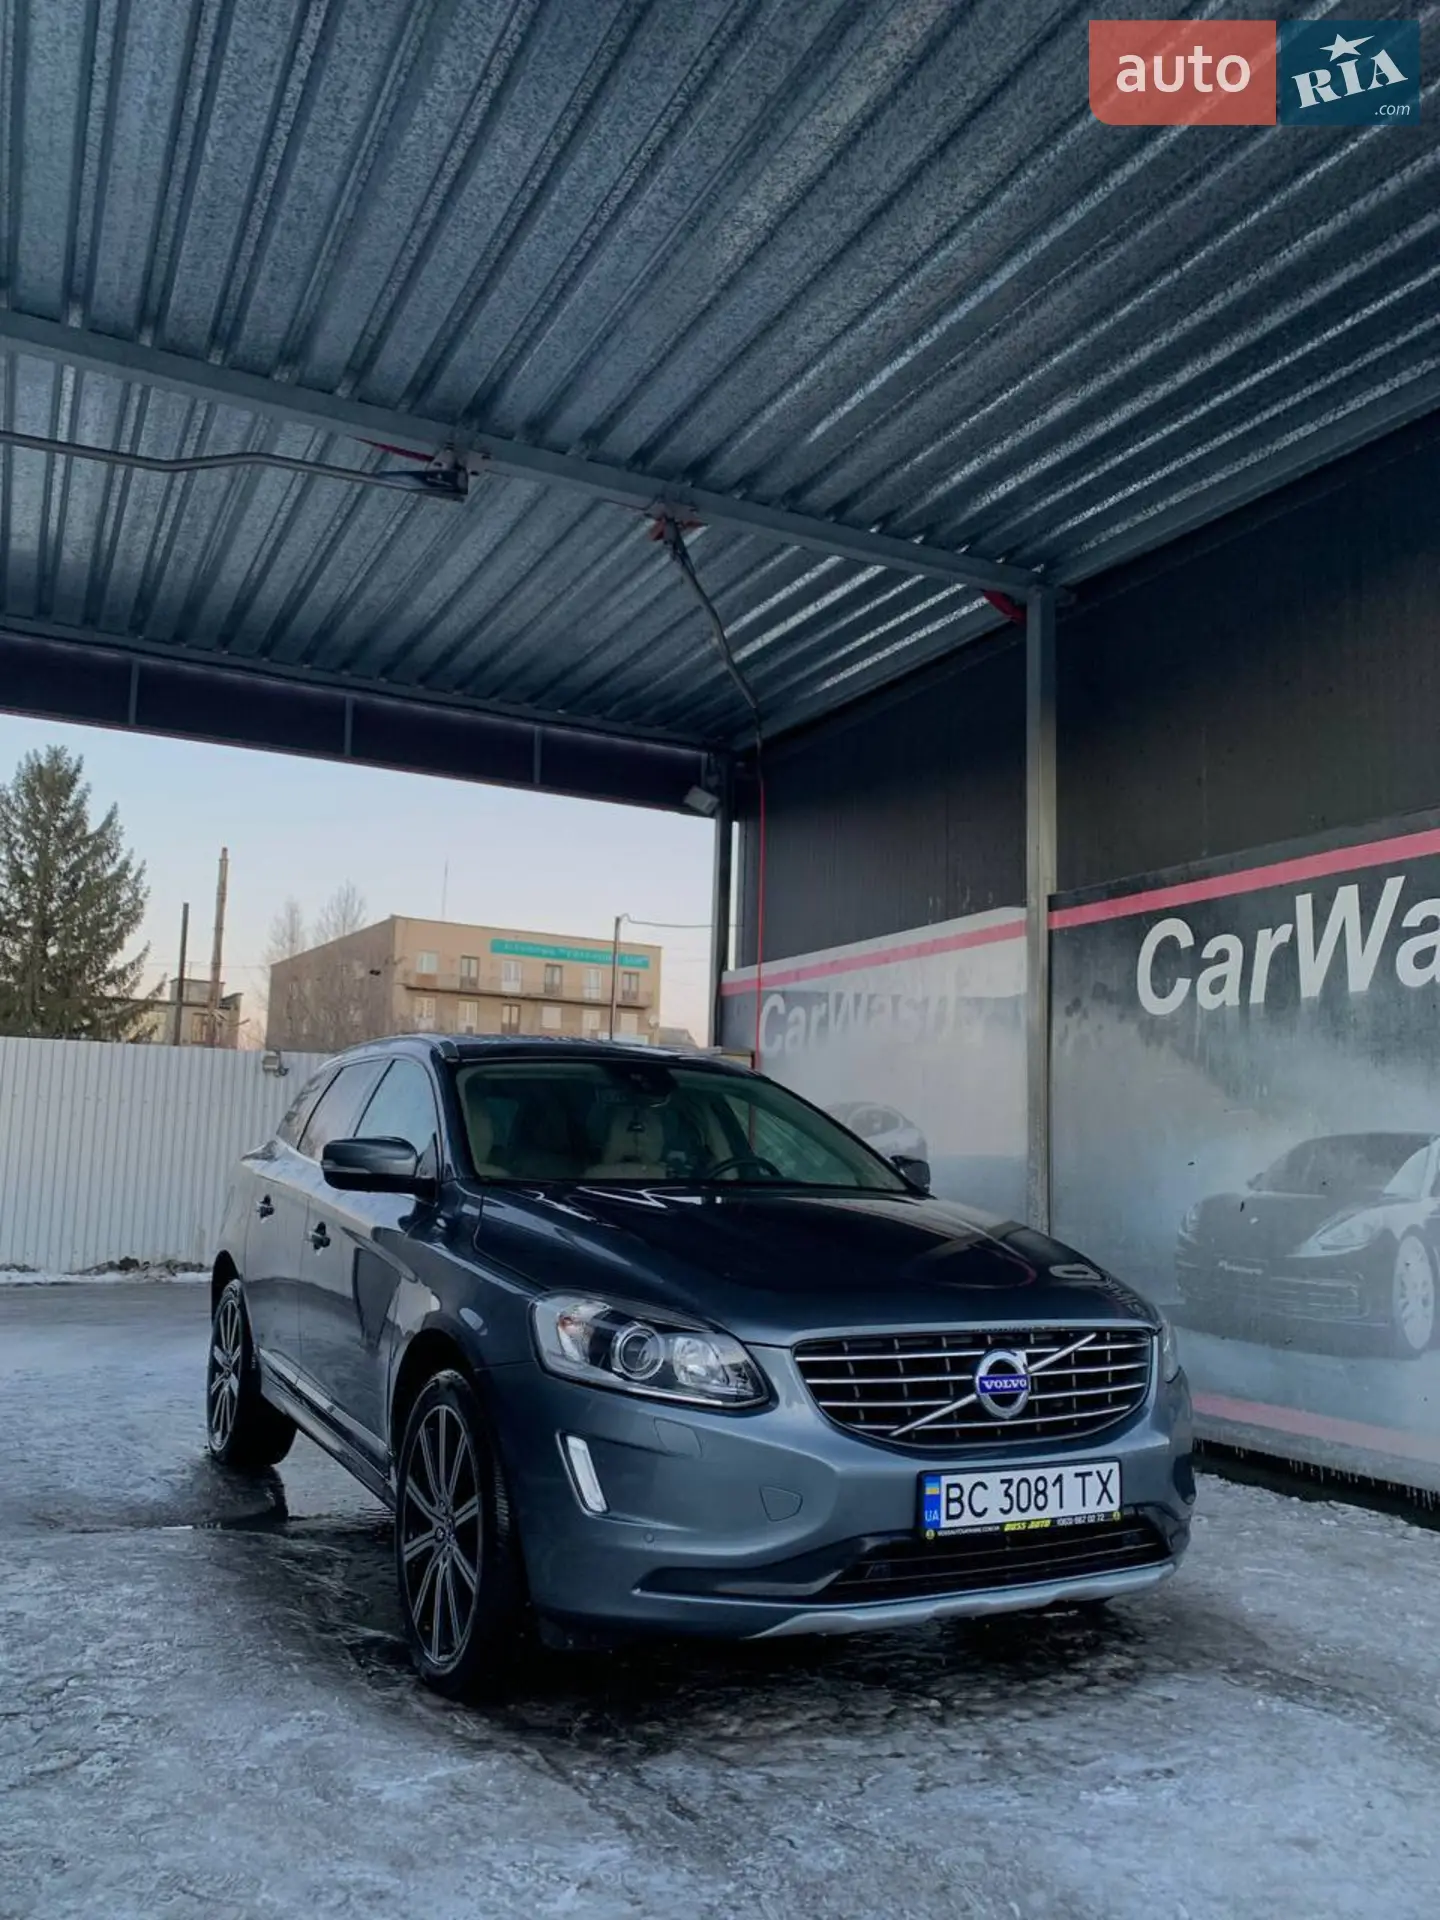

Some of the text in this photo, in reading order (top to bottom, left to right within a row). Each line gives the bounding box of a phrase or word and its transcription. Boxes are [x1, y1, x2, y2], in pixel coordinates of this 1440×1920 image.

[981, 1378, 1027, 1390] VOLVO
[945, 1468, 1114, 1521] BC 3081 TX
[924, 1509, 940, 1522] UA
